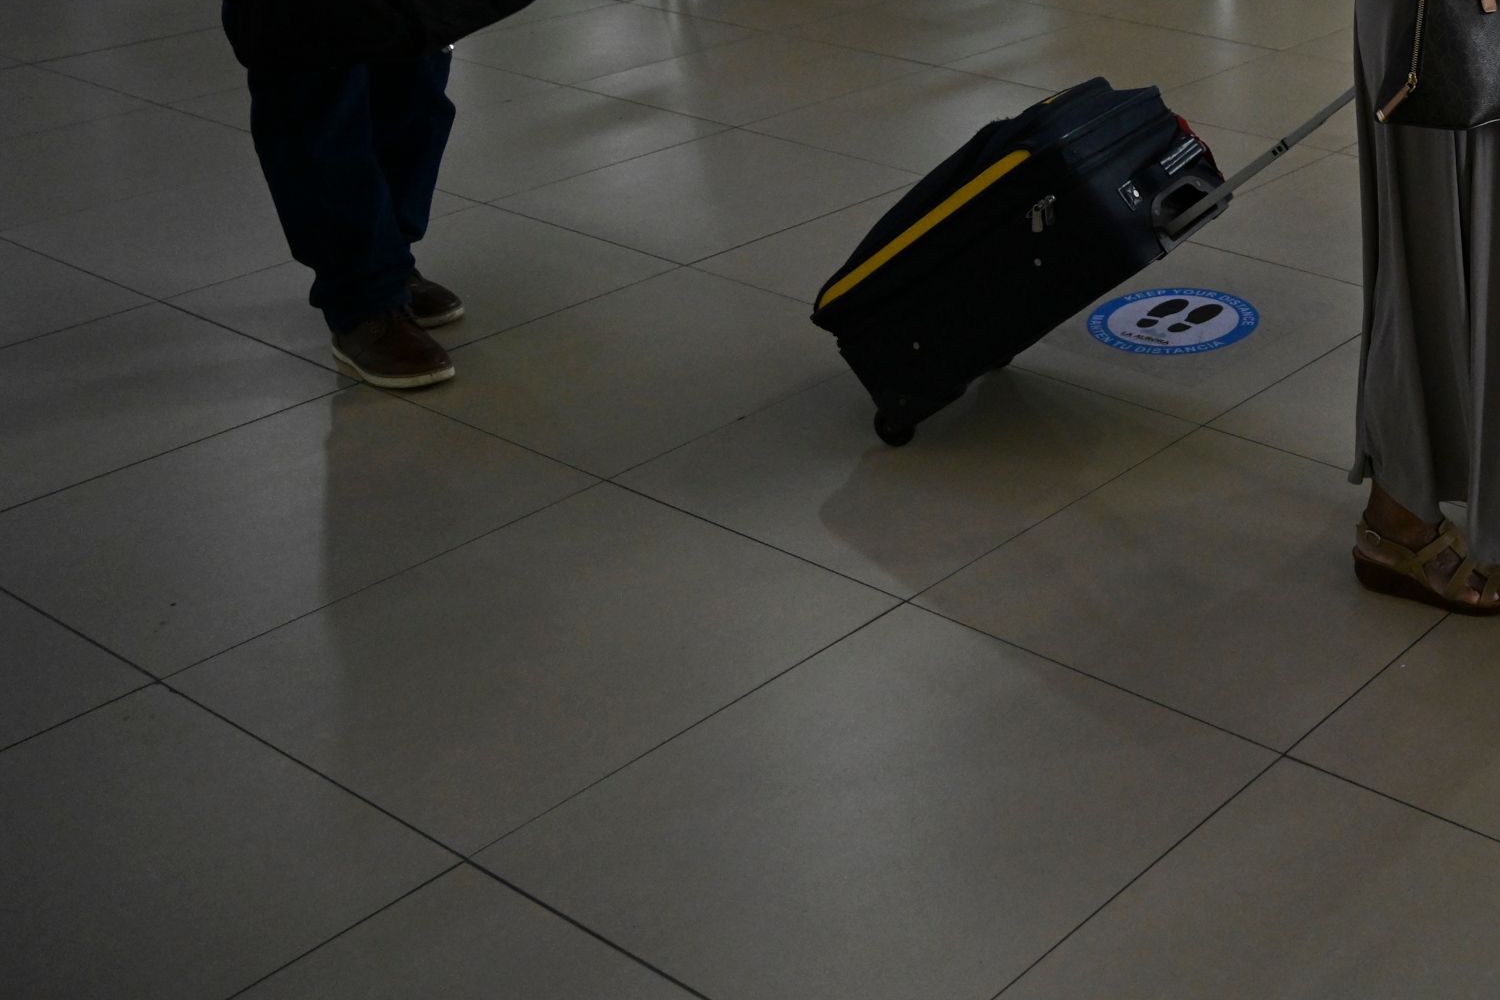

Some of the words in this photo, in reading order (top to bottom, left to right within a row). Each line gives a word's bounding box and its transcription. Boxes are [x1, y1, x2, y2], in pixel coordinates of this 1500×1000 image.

[1124, 289, 1167, 301] KEEP
[1173, 288, 1217, 299] YOUR
[1217, 293, 1255, 326] DISTANCE
[1121, 330, 1134, 338] LA
[1135, 334, 1170, 345] AURORA
[1112, 340, 1130, 350] TU
[1133, 340, 1225, 354] DISTANCIA
